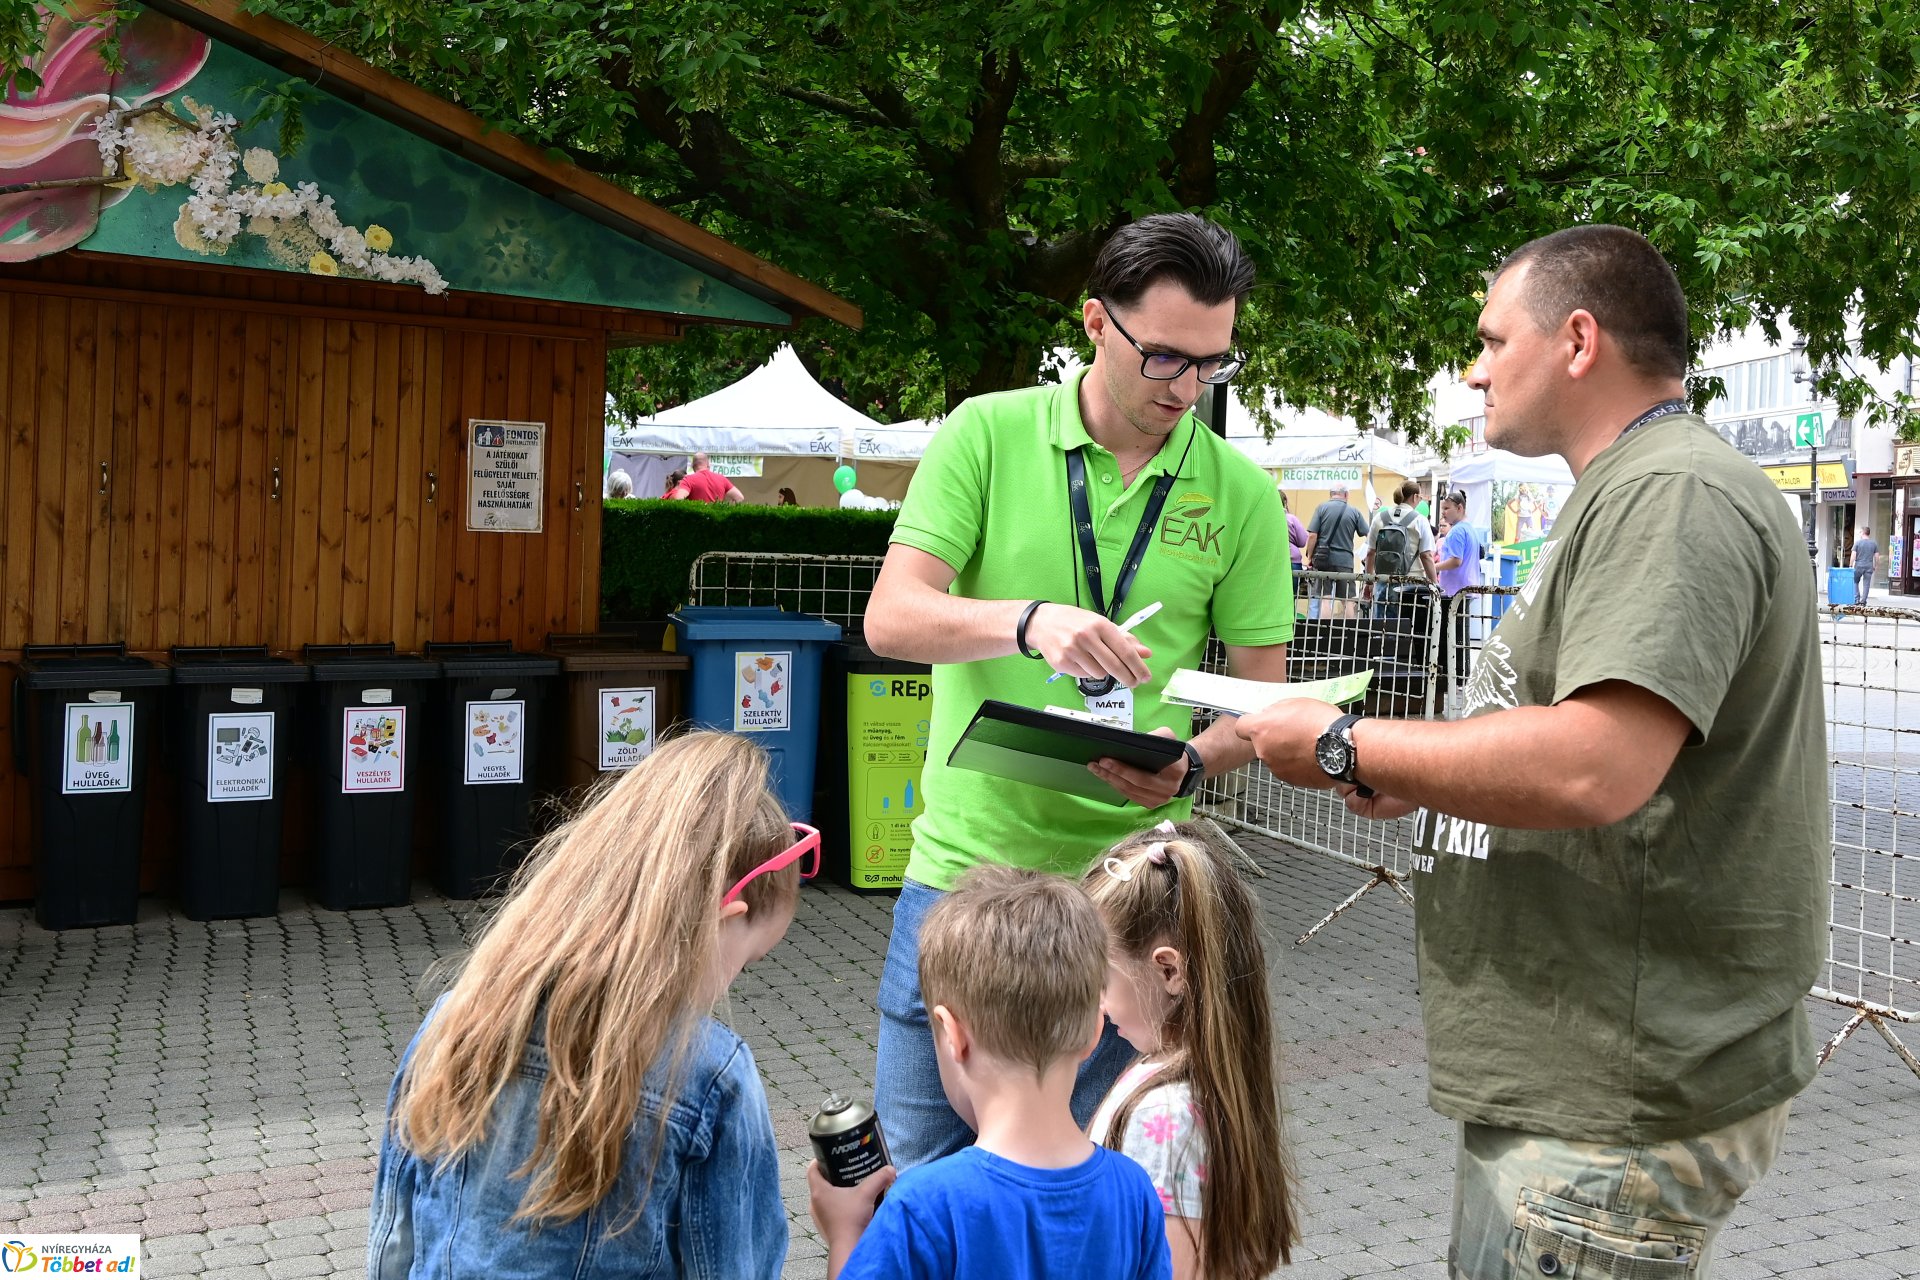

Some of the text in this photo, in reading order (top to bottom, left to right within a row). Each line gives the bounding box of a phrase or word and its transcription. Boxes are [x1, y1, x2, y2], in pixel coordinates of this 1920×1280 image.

[506, 430, 539, 440] FONTOS
[612, 437, 633, 447] EAK
[810, 441, 833, 452] EAK
[859, 443, 881, 454] EAK
[492, 450, 528, 460] JÁTÉKOKAT
[474, 469, 539, 480] FELÜGYELET MELLETT,
[1283, 469, 1359, 480] REGISZTRÁCIÓ
[496, 480, 516, 489] SAJÁT
[478, 499, 533, 509] HASZNÁLHATJÁK!
[1161, 514, 1225, 556] EAK
[891, 680, 933, 701] REp
[1095, 700, 1125, 709] MÁTÉ
[743, 709, 782, 718] SZELEKTÍV
[618, 747, 638, 755] ZÖLD
[85, 770, 110, 779] ÜVEG
[73, 778, 121, 787] HULLADÉK
[216, 778, 266, 786] ELEKTRONIKAI
